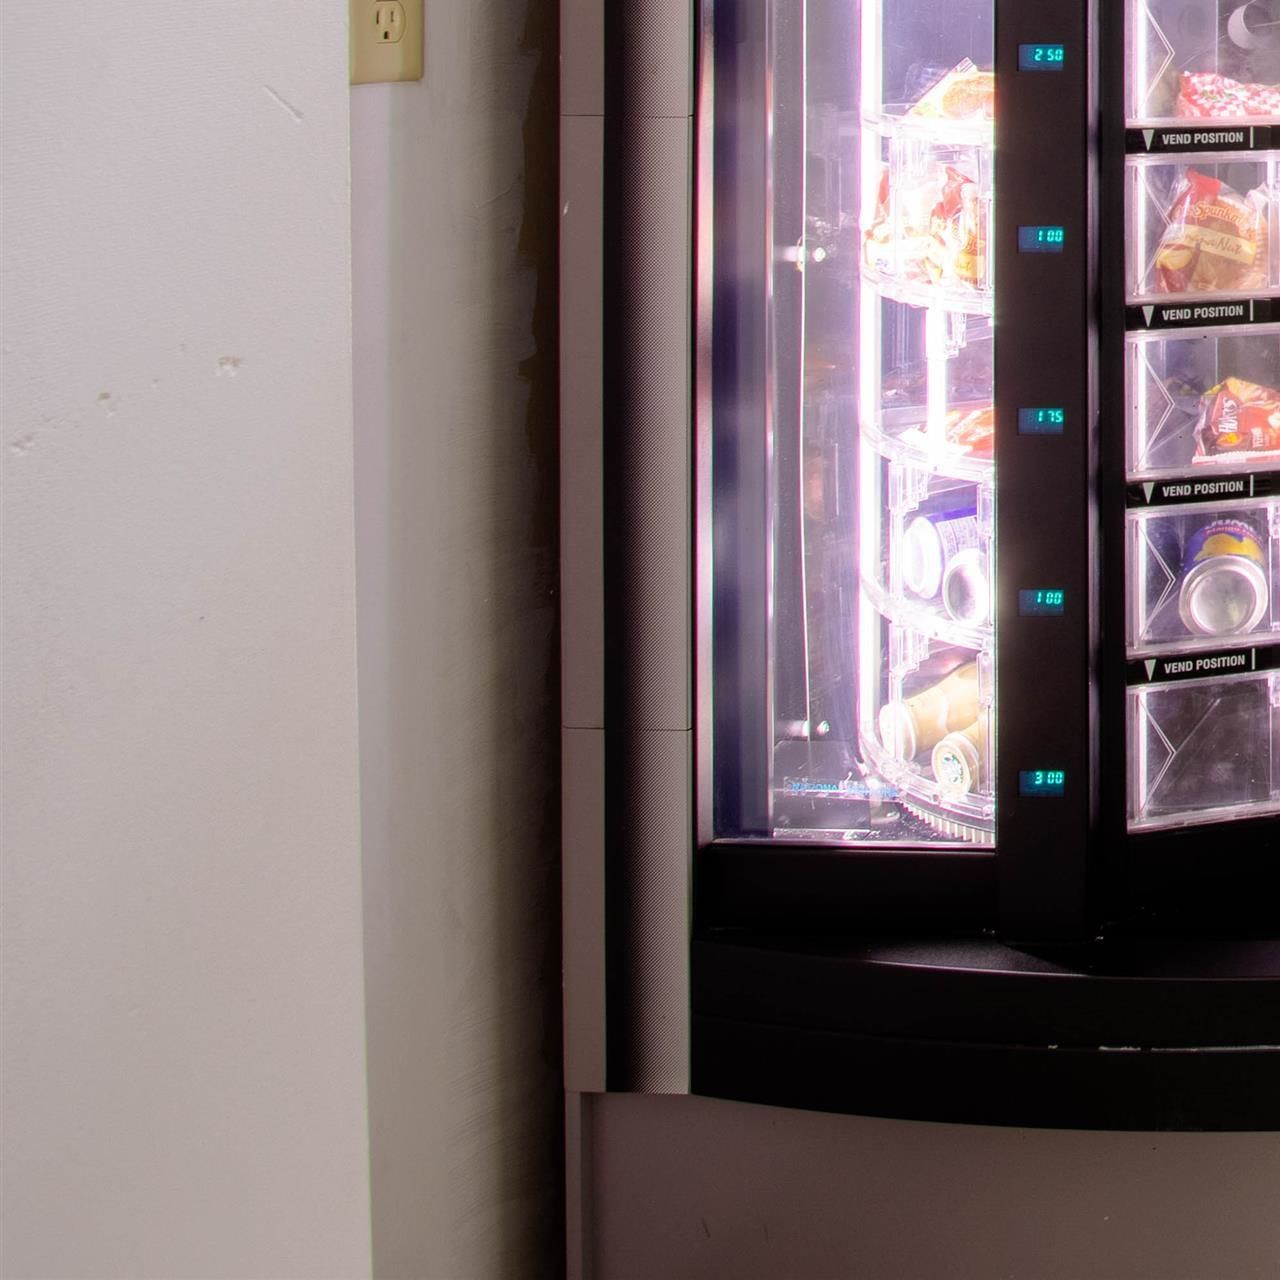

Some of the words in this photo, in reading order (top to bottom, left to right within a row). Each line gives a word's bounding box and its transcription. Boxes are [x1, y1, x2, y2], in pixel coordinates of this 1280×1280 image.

[1162, 133, 1192, 145] VEND
[1194, 131, 1244, 144] POSITION
[1162, 307, 1192, 320] VEND
[1194, 305, 1244, 319] POSITION
[1162, 483, 1192, 497] VEND
[1194, 480, 1244, 495] POSITION
[1164, 661, 1194, 674] VEND
[1196, 655, 1246, 671] POSITION
